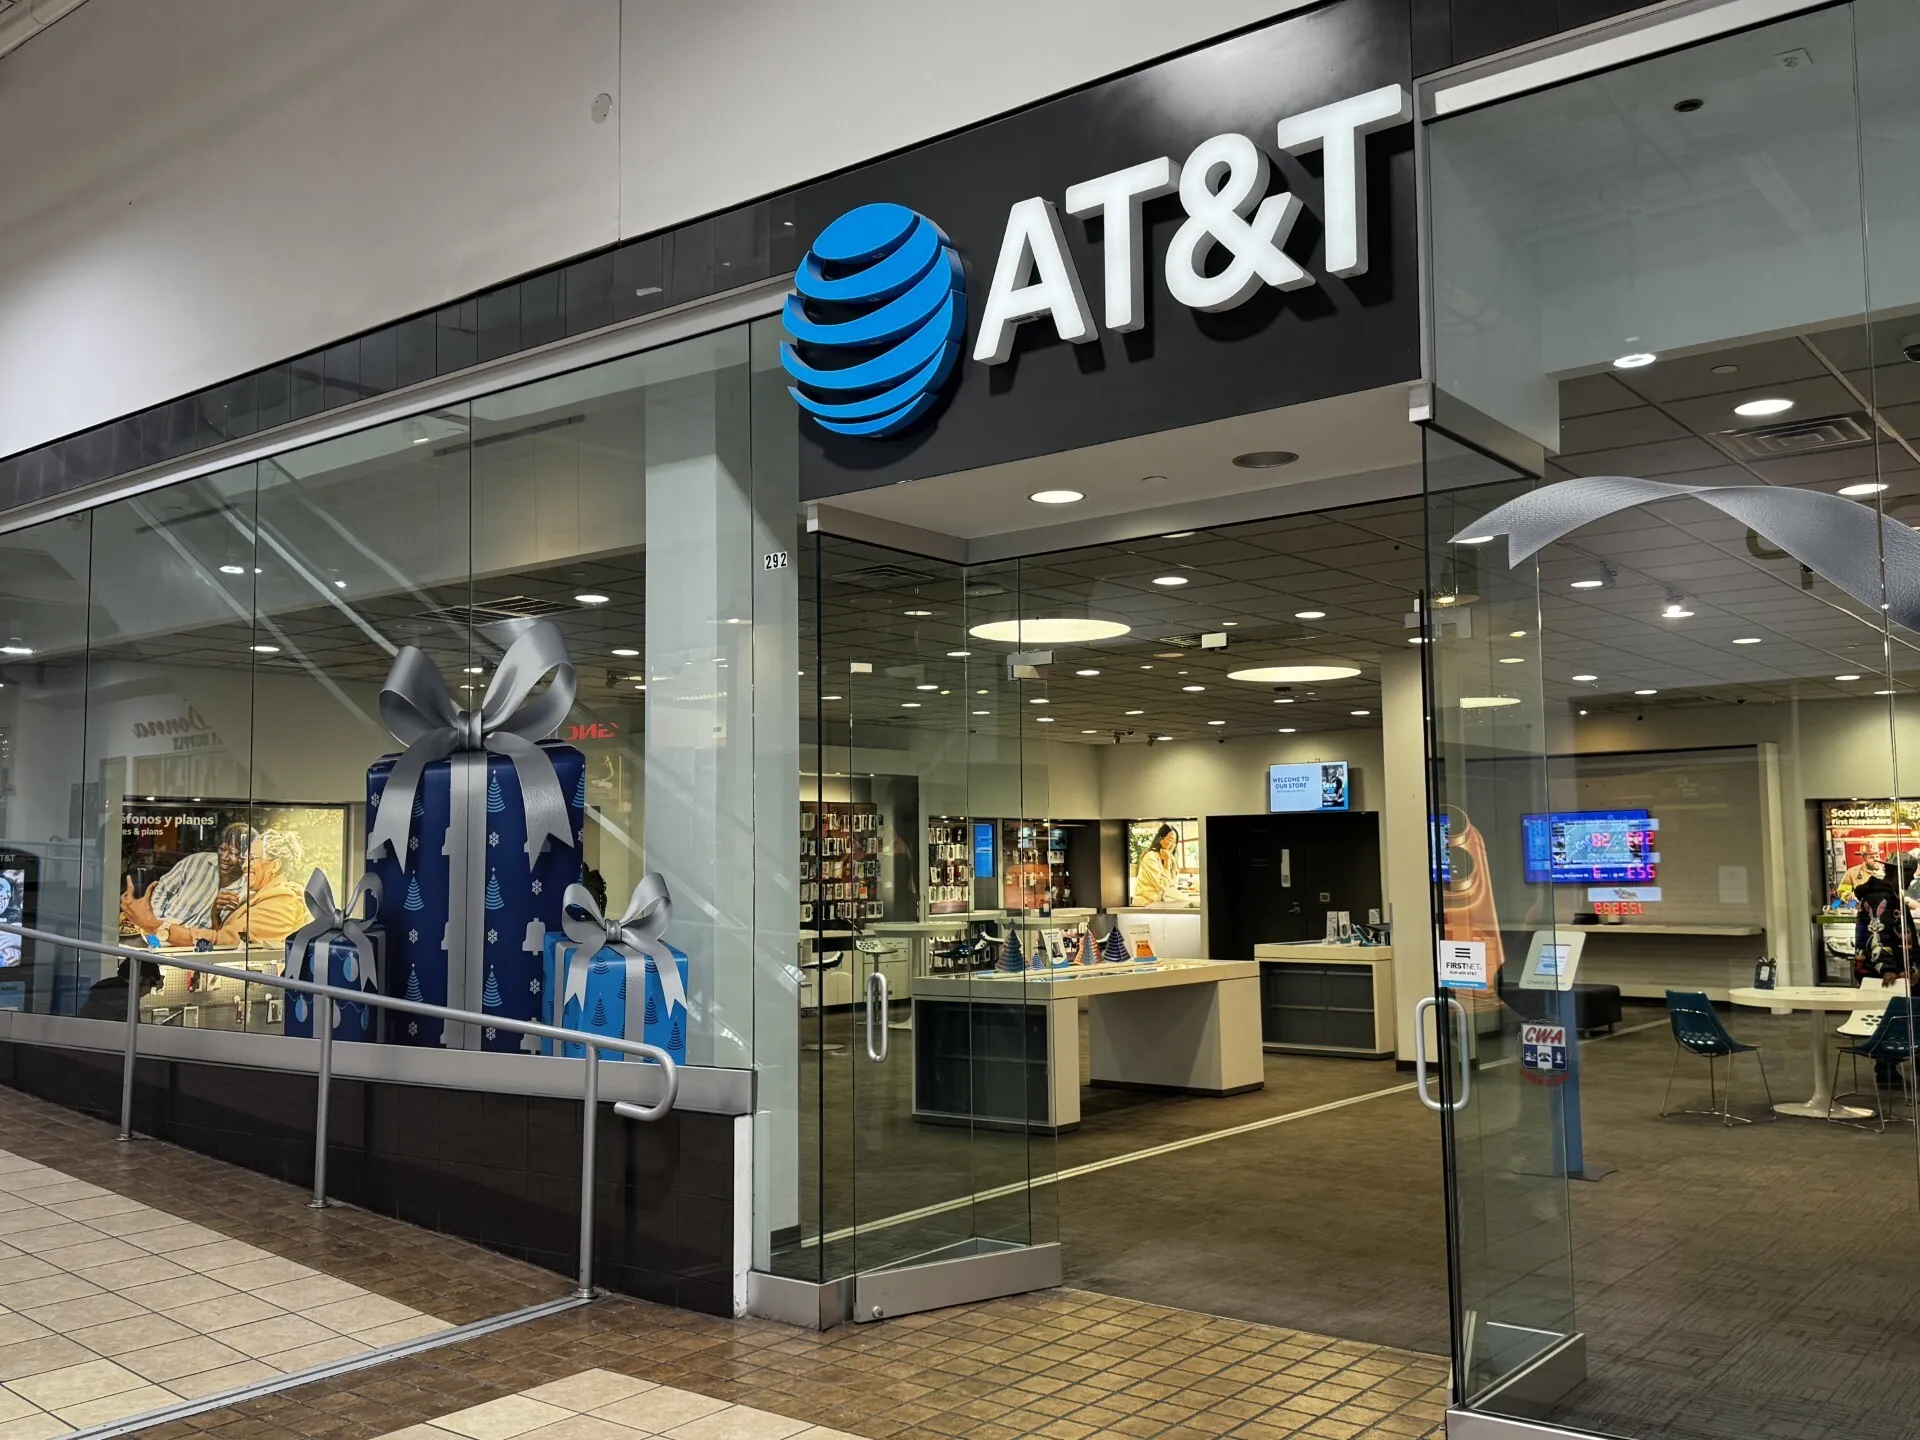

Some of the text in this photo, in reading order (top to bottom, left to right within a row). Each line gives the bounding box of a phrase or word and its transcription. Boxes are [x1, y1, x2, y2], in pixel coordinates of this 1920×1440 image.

[973, 83, 1412, 365] AT&T
[766, 553, 786, 569] 292
[1831, 807, 1891, 817] Socorristas
[163, 816, 172, 827] y
[174, 813, 214, 828] planes
[133, 828, 140, 836] &
[141, 828, 164, 837] plans
[1525, 1027, 1563, 1045] CWA
